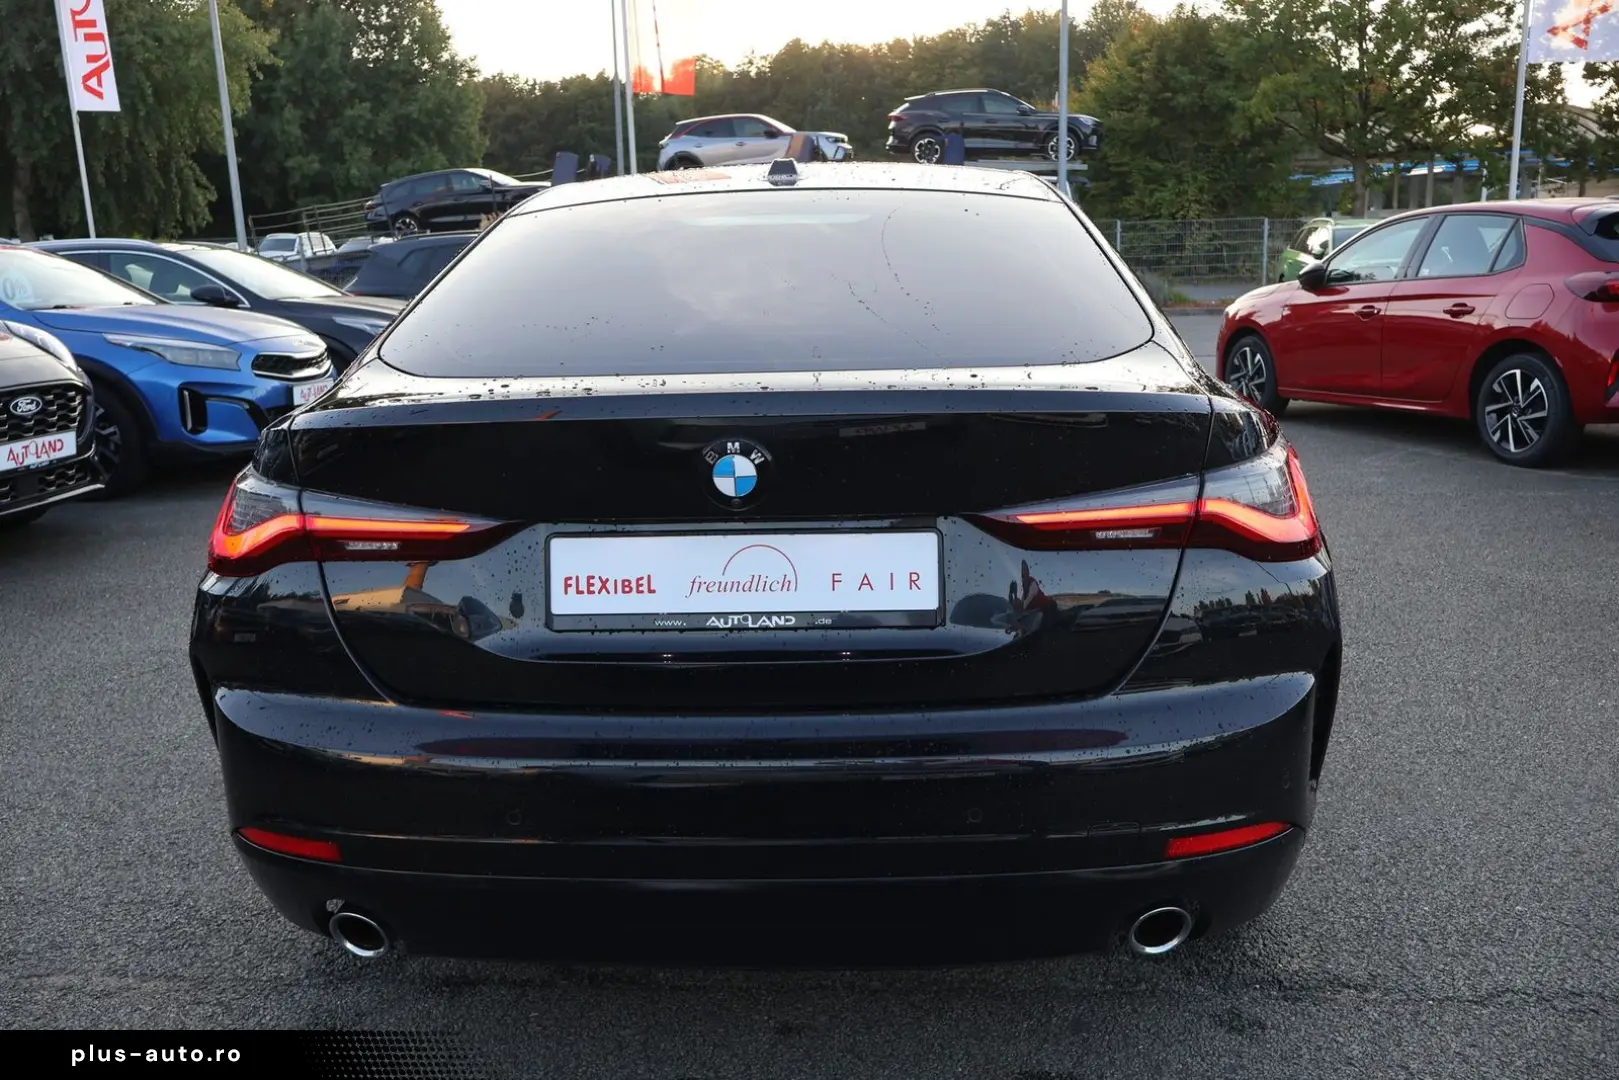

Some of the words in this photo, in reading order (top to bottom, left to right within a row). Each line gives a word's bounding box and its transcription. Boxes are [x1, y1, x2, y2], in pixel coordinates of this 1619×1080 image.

[16, 399, 37, 412] Ford
[7, 438, 64, 466] AUTOLAND
[703, 441, 765, 465] BMW
[563, 574, 656, 595] FLEXIBEL
[685, 574, 792, 598] freundlich
[831, 571, 921, 591] FAIR
[654, 618, 687, 627] www.
[706, 613, 796, 628] AUTOLAND
[814, 616, 833, 626] .de
